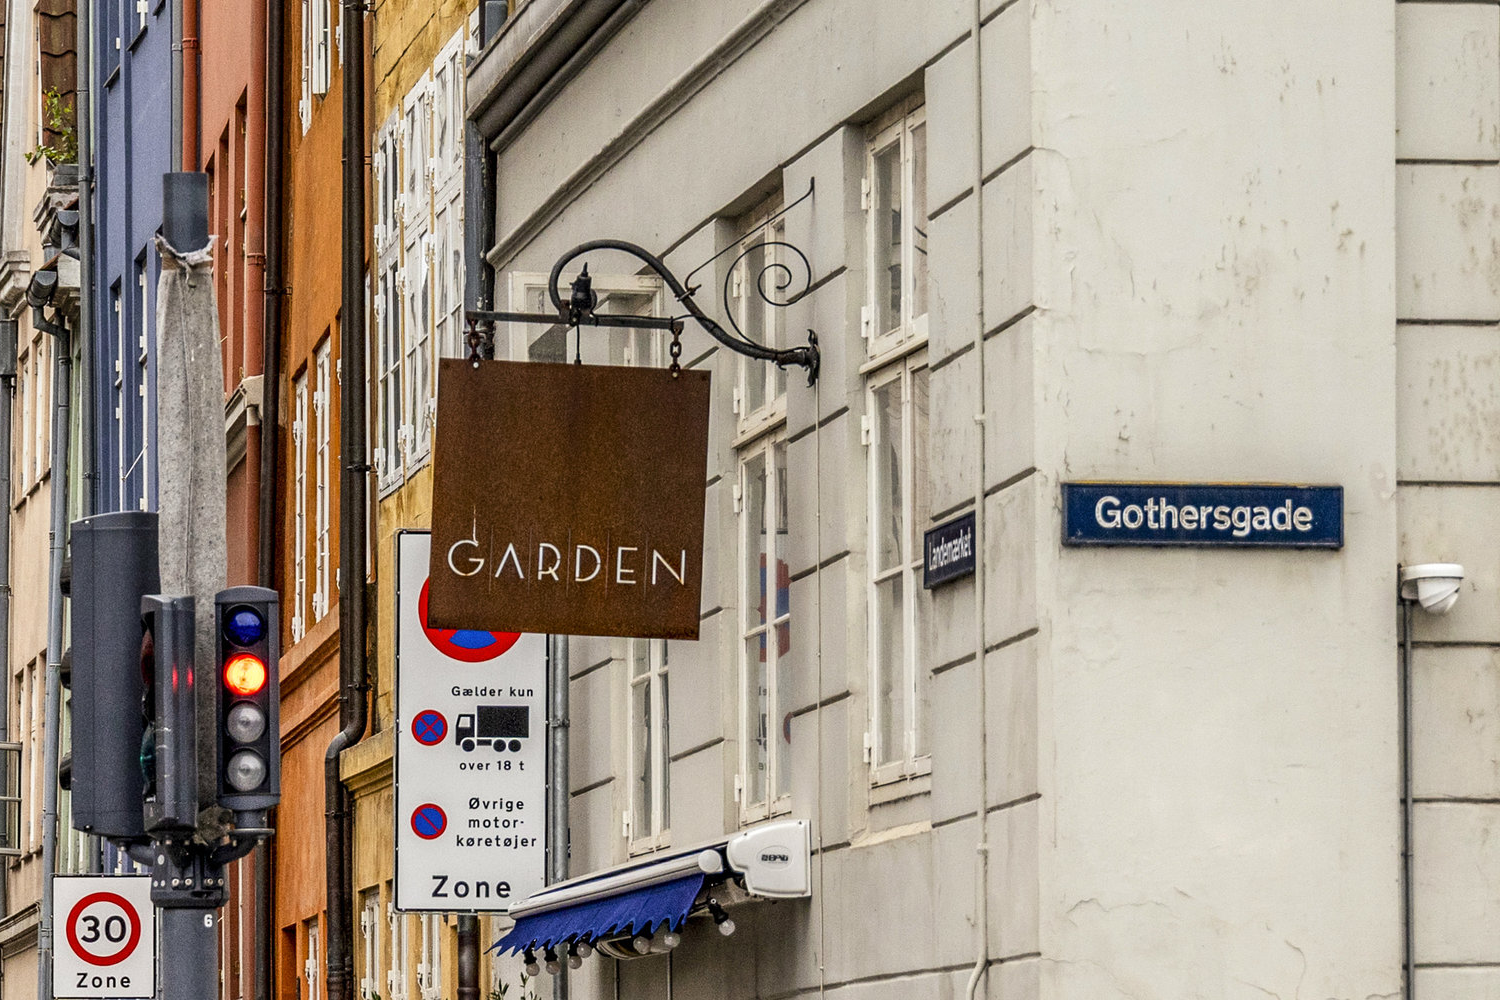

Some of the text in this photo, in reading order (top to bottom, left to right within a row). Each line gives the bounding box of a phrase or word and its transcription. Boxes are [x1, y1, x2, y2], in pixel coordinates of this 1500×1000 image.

[1095, 495, 1313, 537] Gothersgade
[928, 526, 972, 571] Landemærket
[447, 528, 687, 586] GARDEN
[451, 685, 534, 697] Gælder kun
[459, 760, 525, 771] over 18 t
[468, 797, 525, 812] Øvrige
[468, 816, 525, 829] motor-
[456, 834, 537, 850] køretøjer
[431, 875, 511, 899] Zone
[81, 915, 127, 943] 30
[203, 914, 213, 928] 6
[76, 972, 131, 989] Zone
